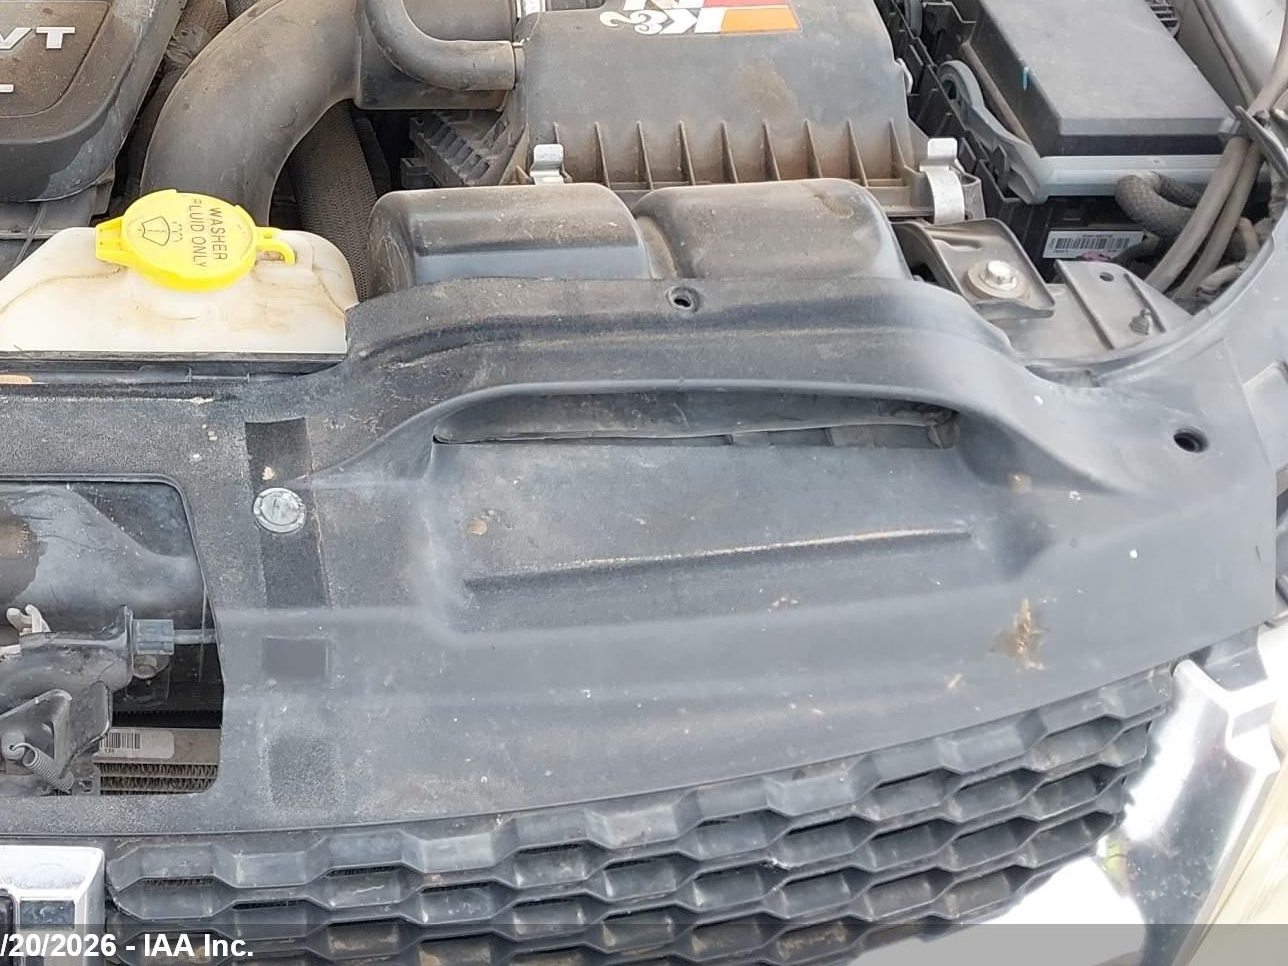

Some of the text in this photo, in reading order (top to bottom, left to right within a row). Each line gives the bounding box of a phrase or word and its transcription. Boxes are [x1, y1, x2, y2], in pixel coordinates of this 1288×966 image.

[188, 198, 208, 268] FLUID ONLY
[209, 207, 228, 261] WASHER
